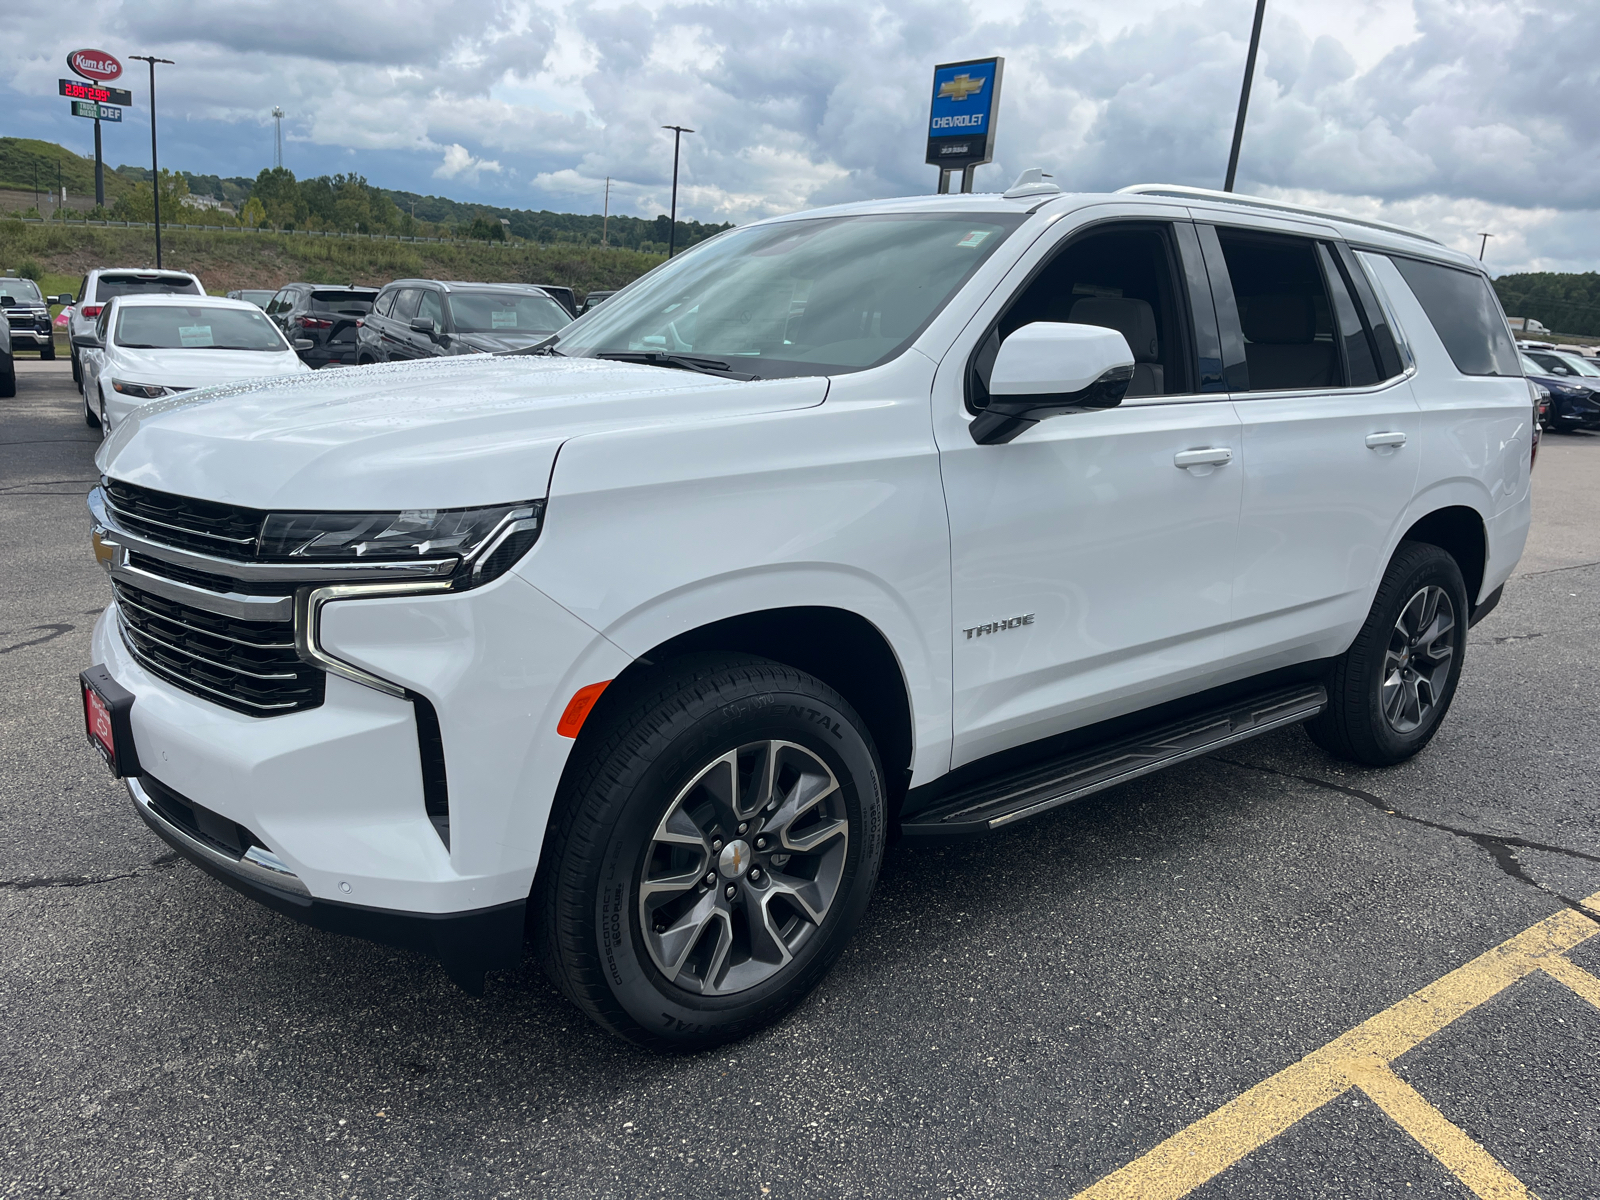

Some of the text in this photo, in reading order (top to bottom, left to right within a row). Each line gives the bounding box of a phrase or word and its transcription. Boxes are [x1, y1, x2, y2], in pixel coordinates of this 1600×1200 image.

[76, 54, 118, 75] Kum & Go
[79, 102, 98, 111] TRUCK
[79, 109, 98, 118] DIESEL
[100, 107, 121, 119] DEF
[932, 113, 984, 128] CHEVROLET
[962, 612, 1036, 640] TAHOE
[606, 861, 617, 881] LX
[602, 885, 623, 986] CROSSCONTACT
